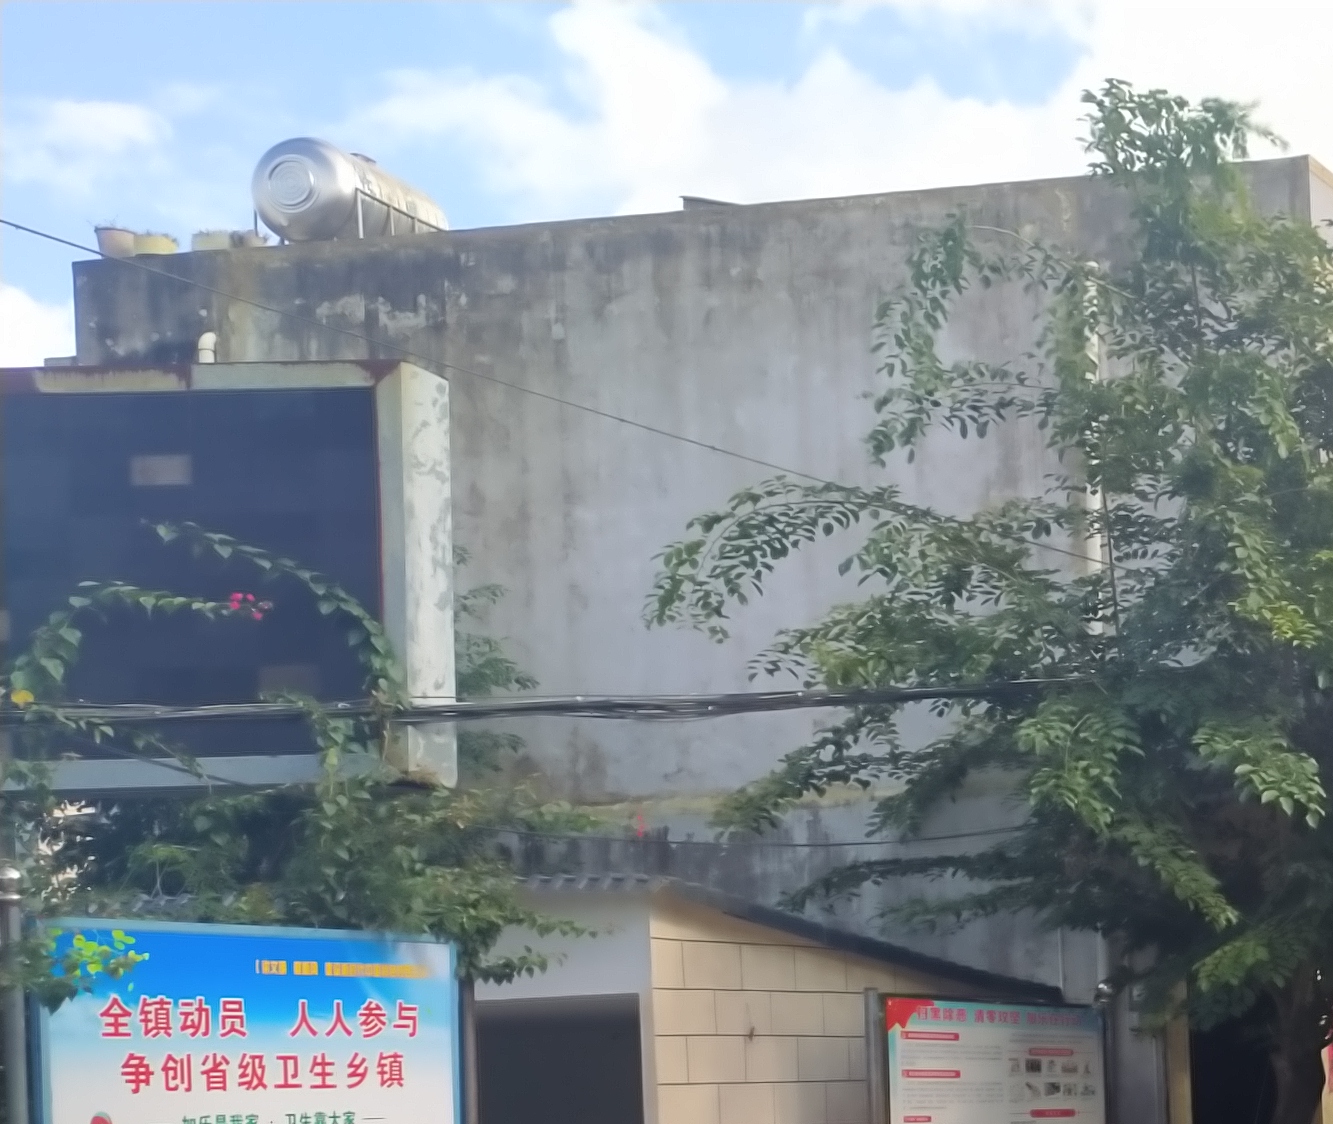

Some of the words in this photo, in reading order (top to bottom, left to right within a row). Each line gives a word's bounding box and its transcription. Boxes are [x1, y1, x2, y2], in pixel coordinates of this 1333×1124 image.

[100, 996, 247, 1038] 全镇动员
[290, 999, 418, 1038] 人人参与
[121, 1051, 404, 1094] 争创省级卫生乡镇
